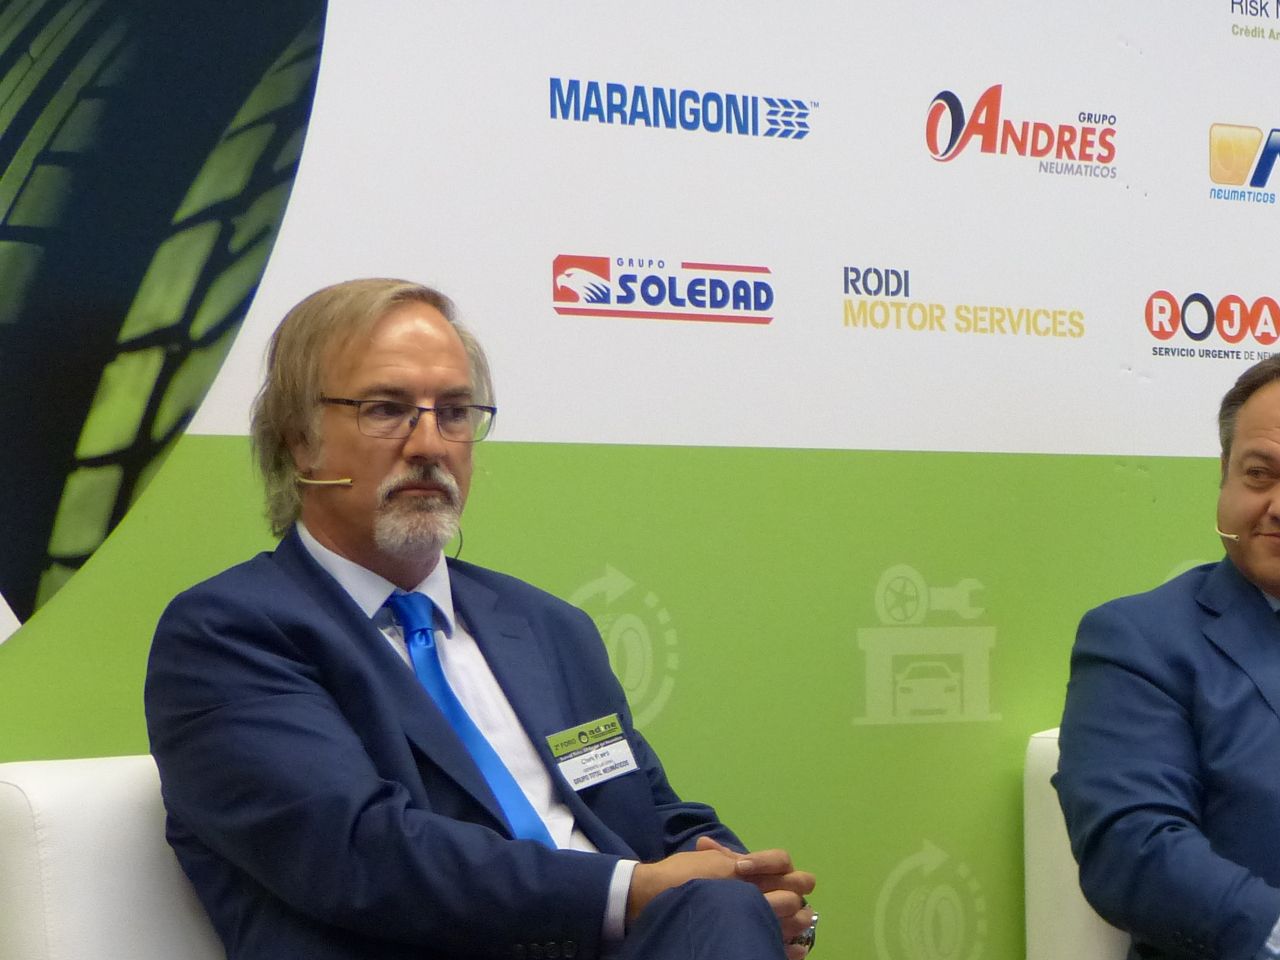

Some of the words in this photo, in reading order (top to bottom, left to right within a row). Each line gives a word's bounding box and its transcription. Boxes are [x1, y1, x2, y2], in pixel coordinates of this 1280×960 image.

[1231, 24, 1266, 39] Crèdit
[549, 77, 760, 137] MARANGONI
[1078, 111, 1117, 125] GRUPO
[1038, 161, 1117, 179] NEUMATICOS
[1209, 188, 1276, 204] NEUMATICOS
[616, 257, 665, 269] GRUPO
[843, 266, 910, 297] RODI
[616, 273, 775, 312] SOLEDAD
[843, 299, 947, 332] MOTOR
[954, 303, 1086, 339] SERVICES
[1152, 346, 1196, 358] SERVICIO
[1199, 349, 1242, 361] URGENTE
[1244, 351, 1256, 361] DE
